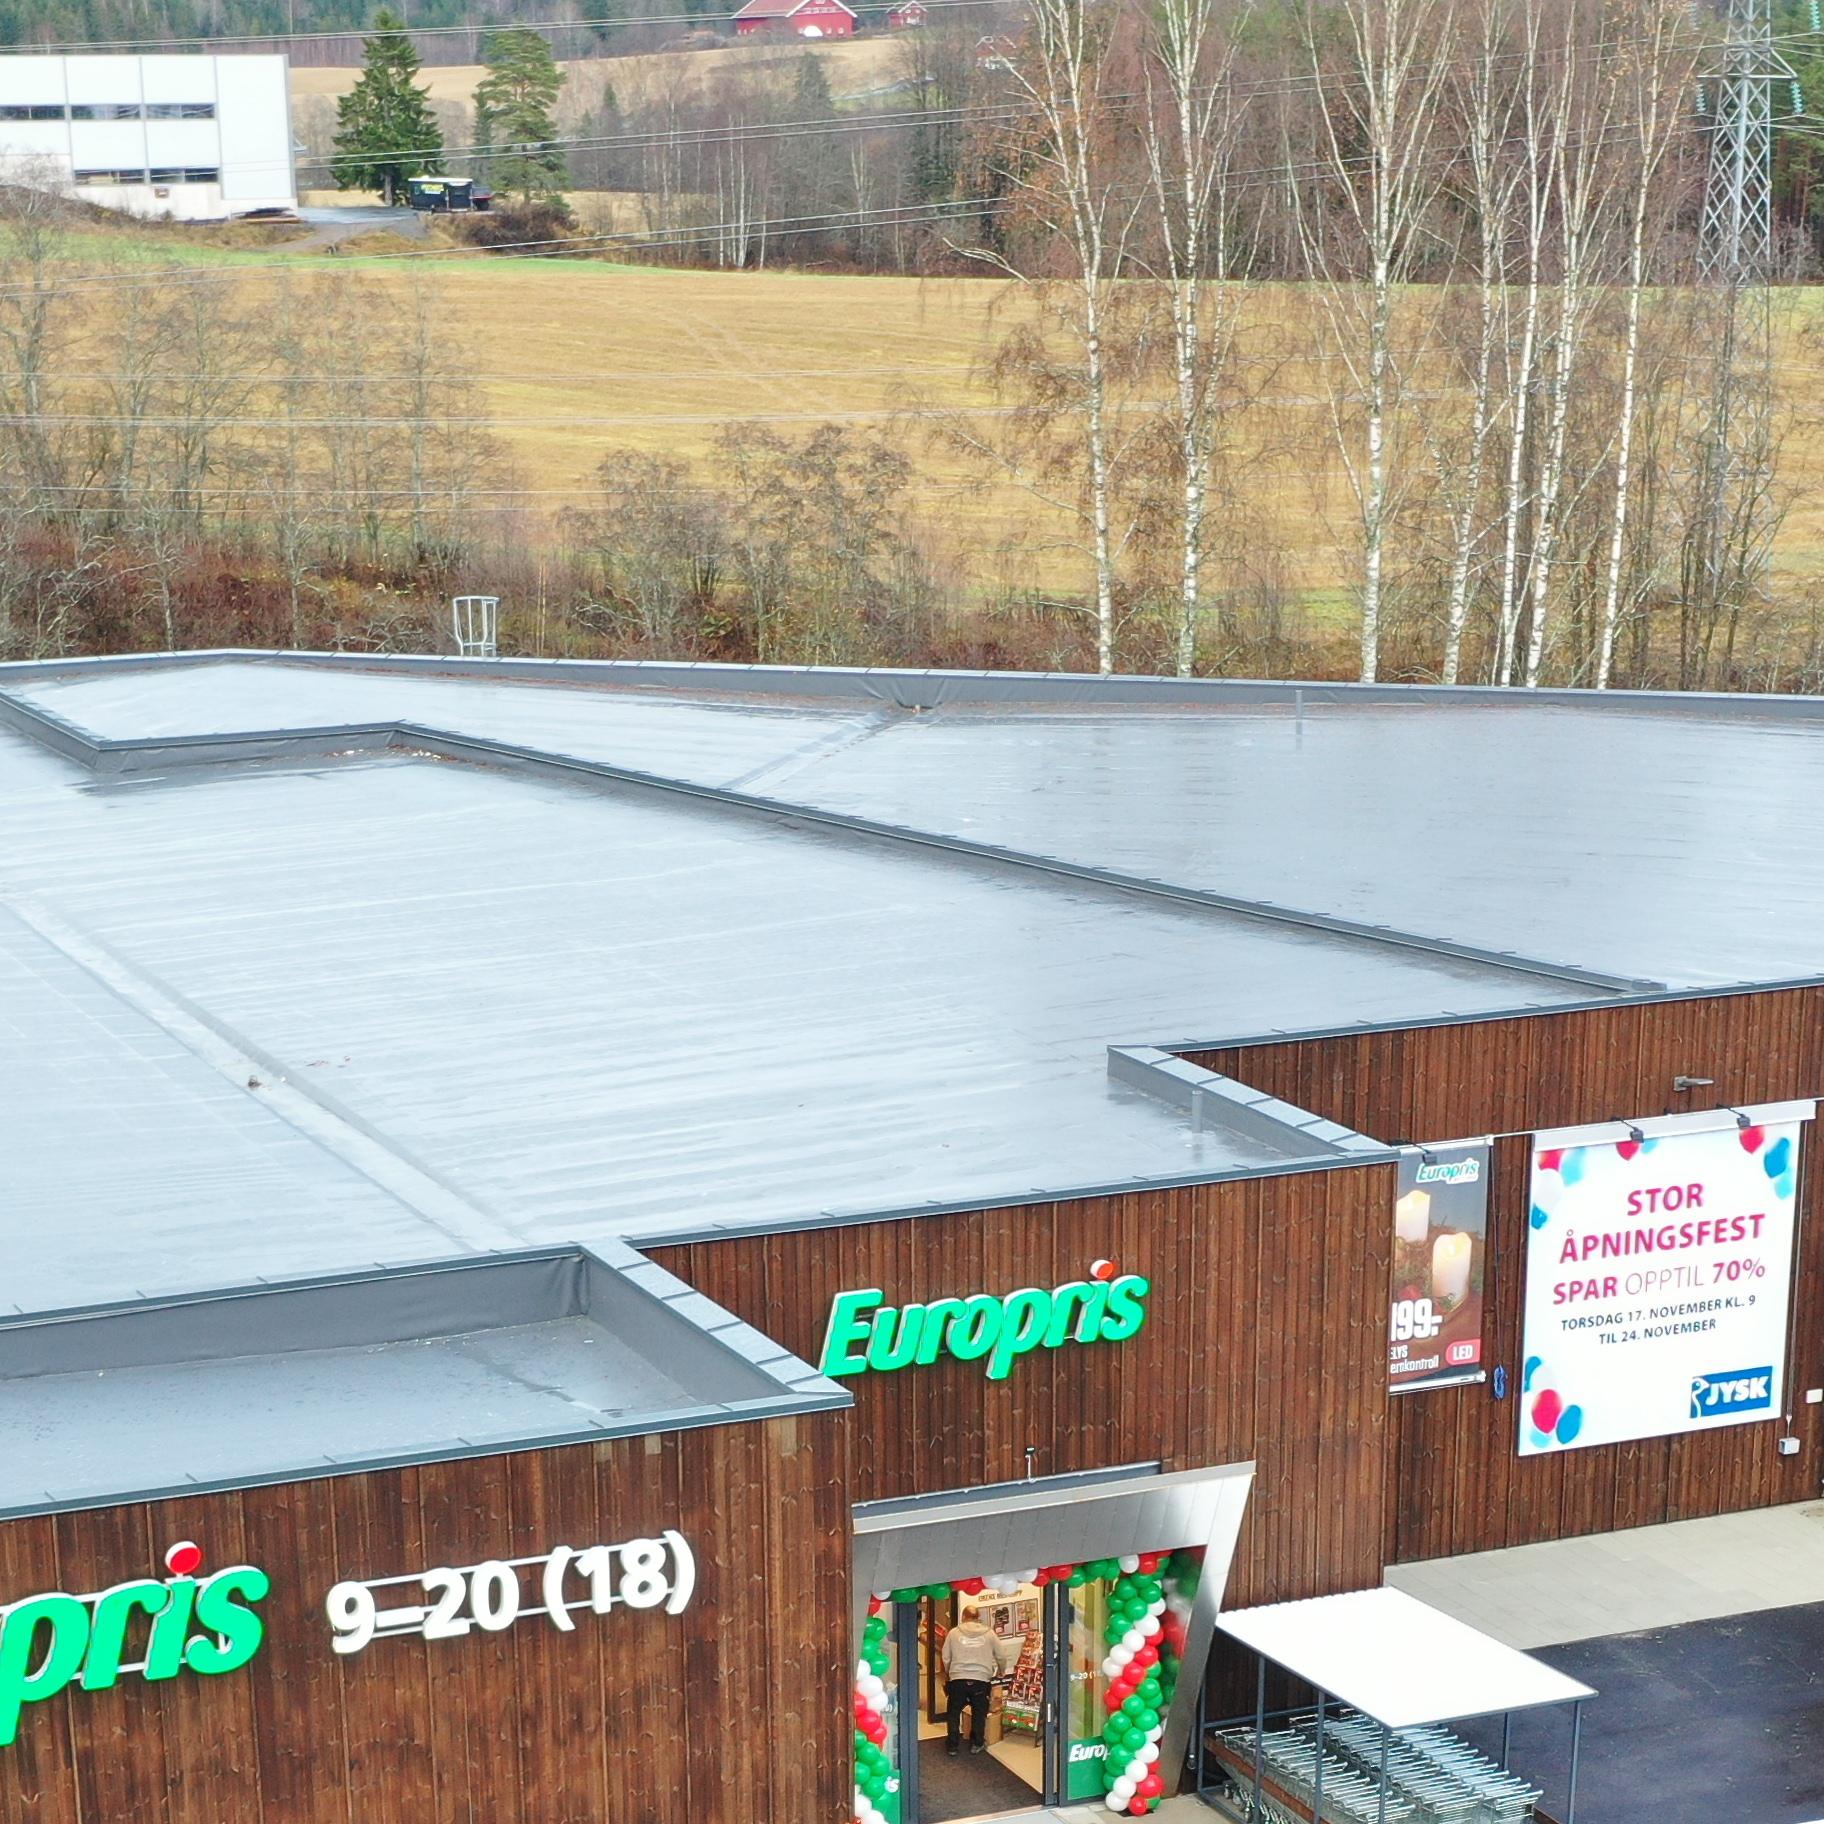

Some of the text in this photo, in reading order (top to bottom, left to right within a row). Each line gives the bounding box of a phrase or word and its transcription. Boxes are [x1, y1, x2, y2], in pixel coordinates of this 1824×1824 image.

[1627, 1183, 1704, 1216] STOR
[1559, 1213, 1766, 1264] ÅPNINGSFEST
[1553, 1257, 1766, 1305] SPAR OPPTIL 70%
[819, 1259, 1150, 1381] Europris
[1561, 1294, 1756, 1331] TORSDAG 17. NOVEMBER KL. 9
[1599, 1318, 1717, 1345] TIL 24. NOVEMBER
[1452, 1344, 1474, 1361] LED
[1705, 1375, 1770, 1406] JYSK
[543, 1529, 696, 1632] (18)
